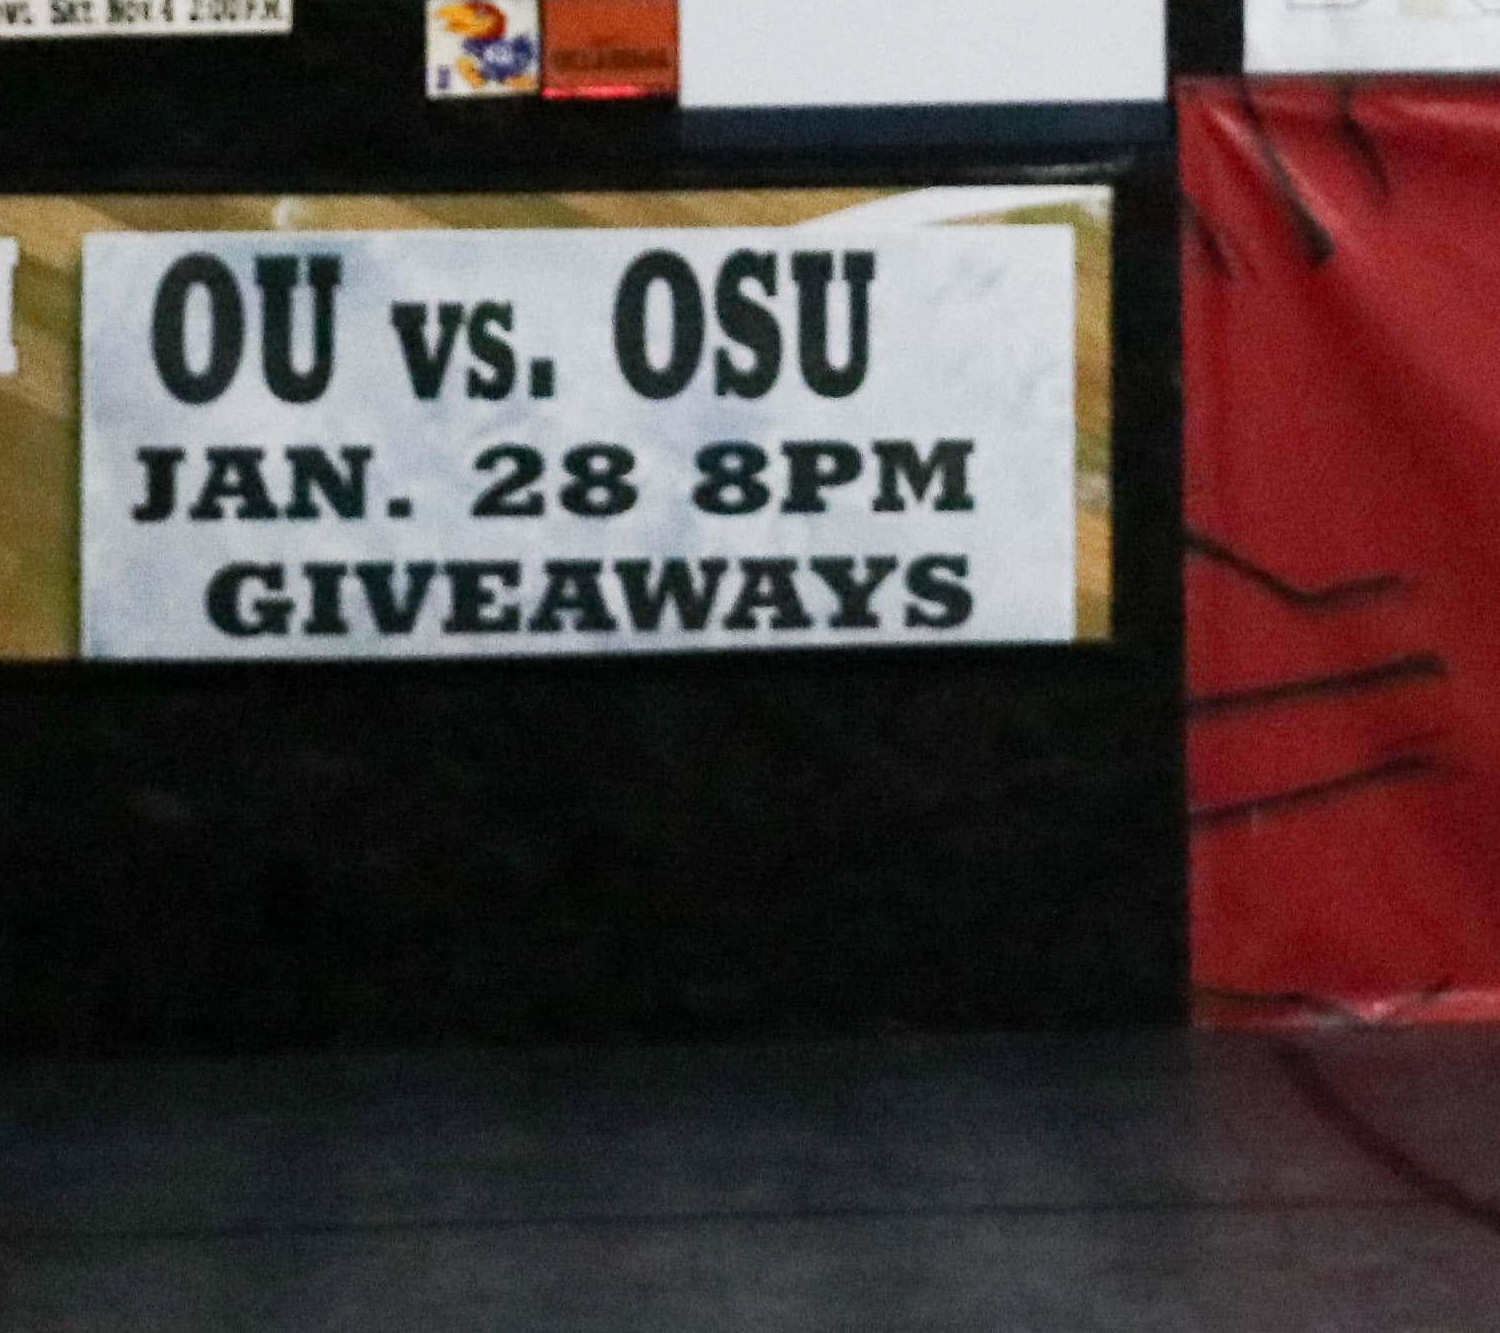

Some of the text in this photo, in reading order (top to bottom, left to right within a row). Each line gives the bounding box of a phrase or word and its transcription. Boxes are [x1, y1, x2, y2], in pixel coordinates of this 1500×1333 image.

[150, 250, 342, 406] OU
[613, 247, 877, 402] OSU
[133, 437, 976, 522] JAN. 28 8PM
[202, 553, 975, 639] GIVEAWAYS
